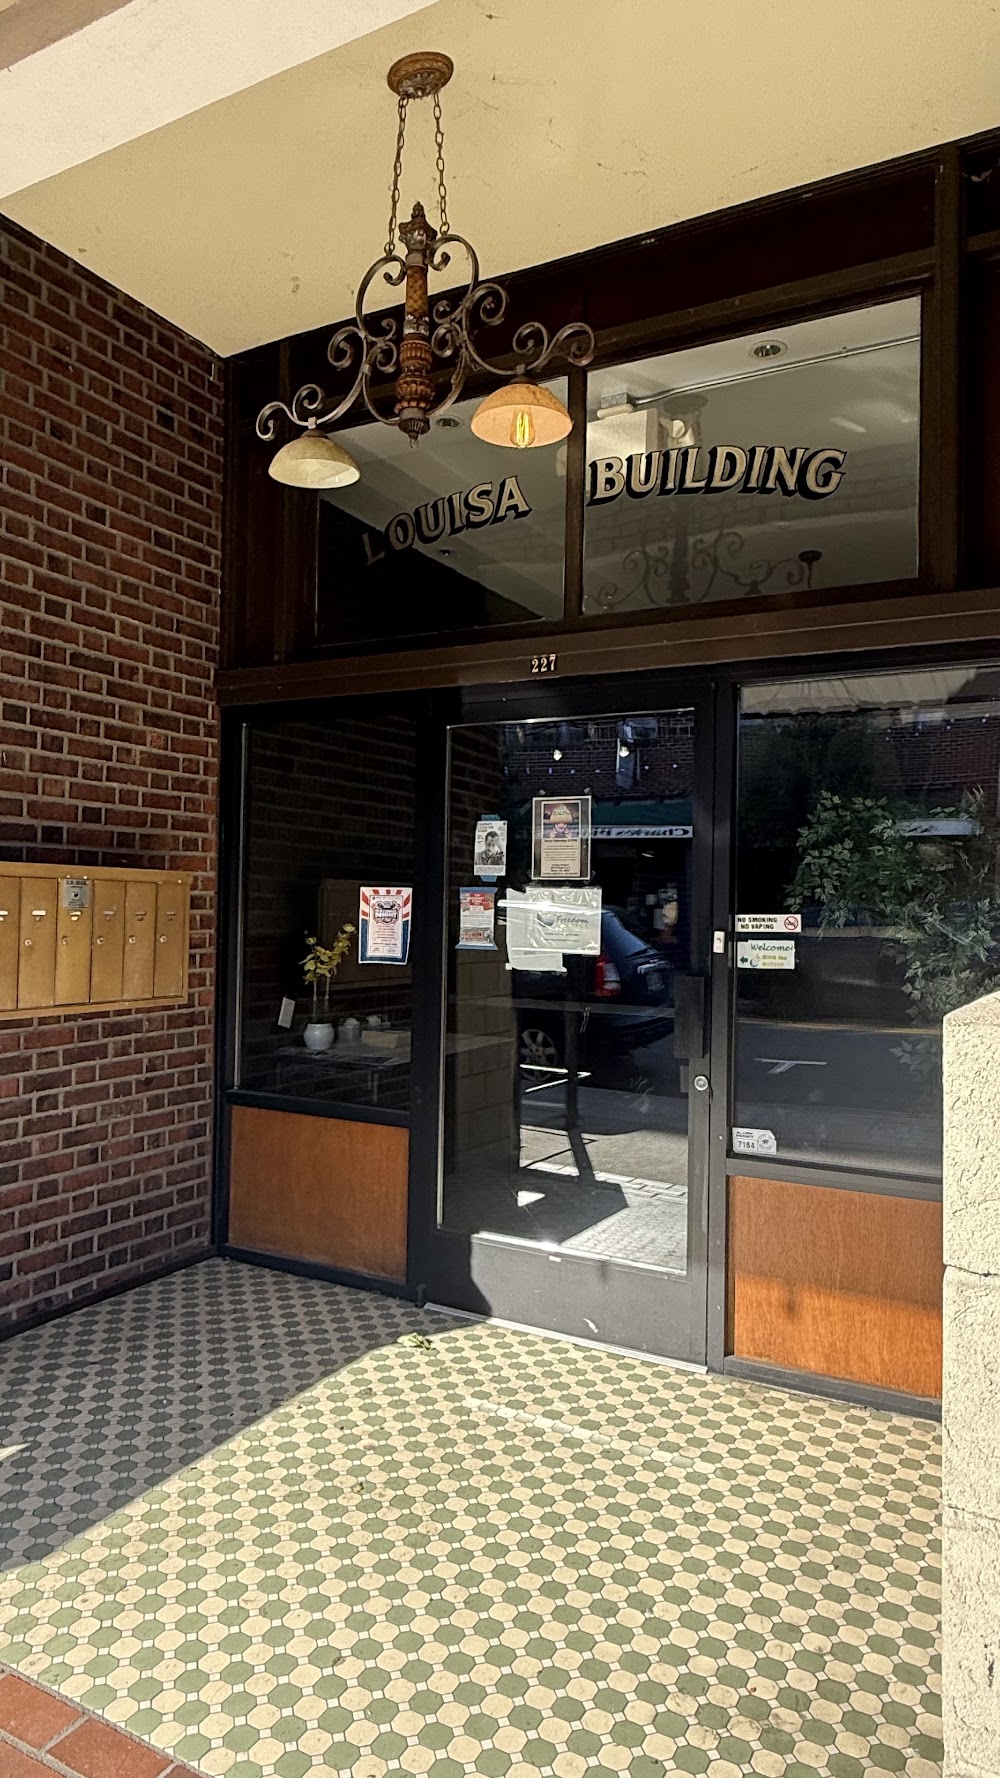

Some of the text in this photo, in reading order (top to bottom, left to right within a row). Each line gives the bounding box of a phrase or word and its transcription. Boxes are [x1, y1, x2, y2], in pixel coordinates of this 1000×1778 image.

[361, 445, 847, 567] LOUISA BUILDING
[531, 653, 556, 673] 227
[557, 916, 589, 924] Freedom
